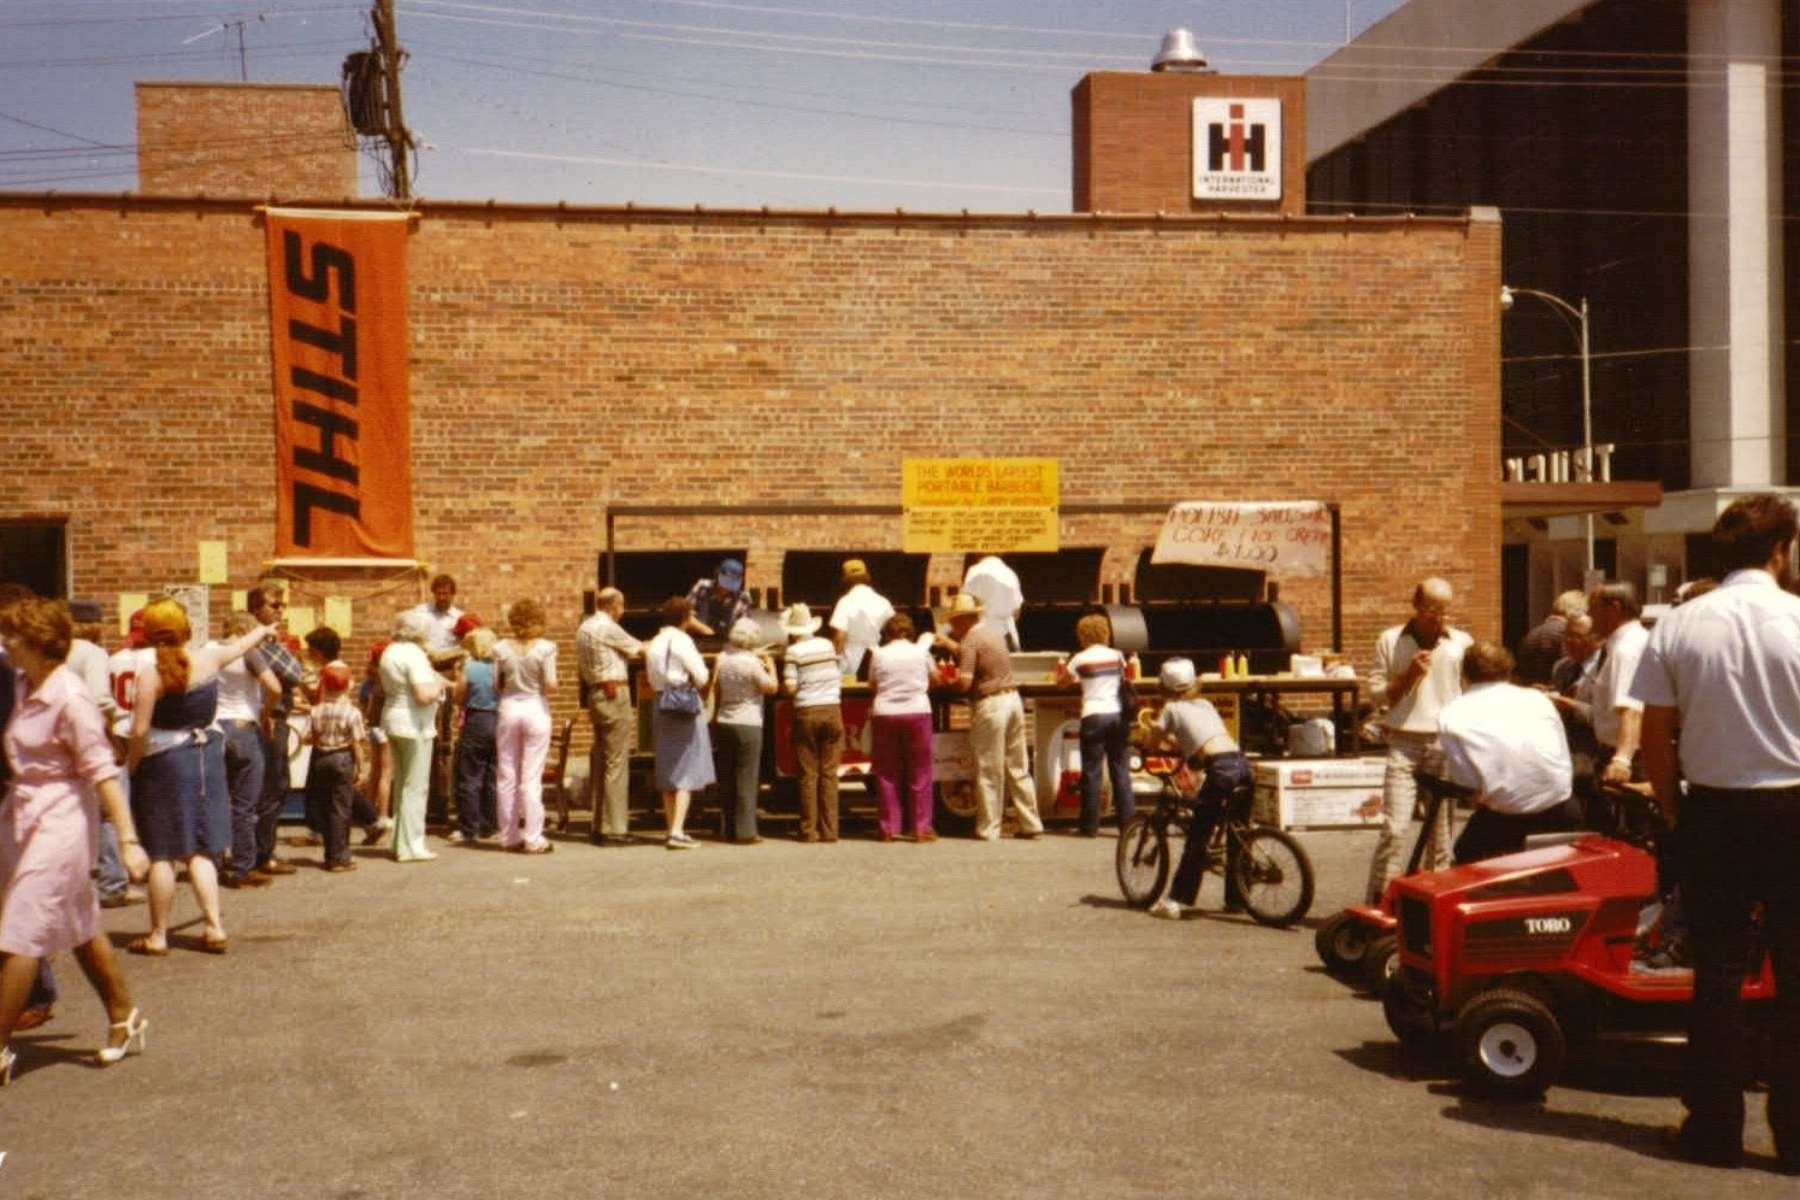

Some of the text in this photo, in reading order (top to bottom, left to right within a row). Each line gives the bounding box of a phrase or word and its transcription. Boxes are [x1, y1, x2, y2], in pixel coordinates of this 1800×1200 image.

[1199, 175, 1275, 184] INTERNATIONAL
[1208, 185, 1266, 193] HARVESTER
[283, 229, 360, 548] STIHL
[1523, 917, 1571, 934] TORO
